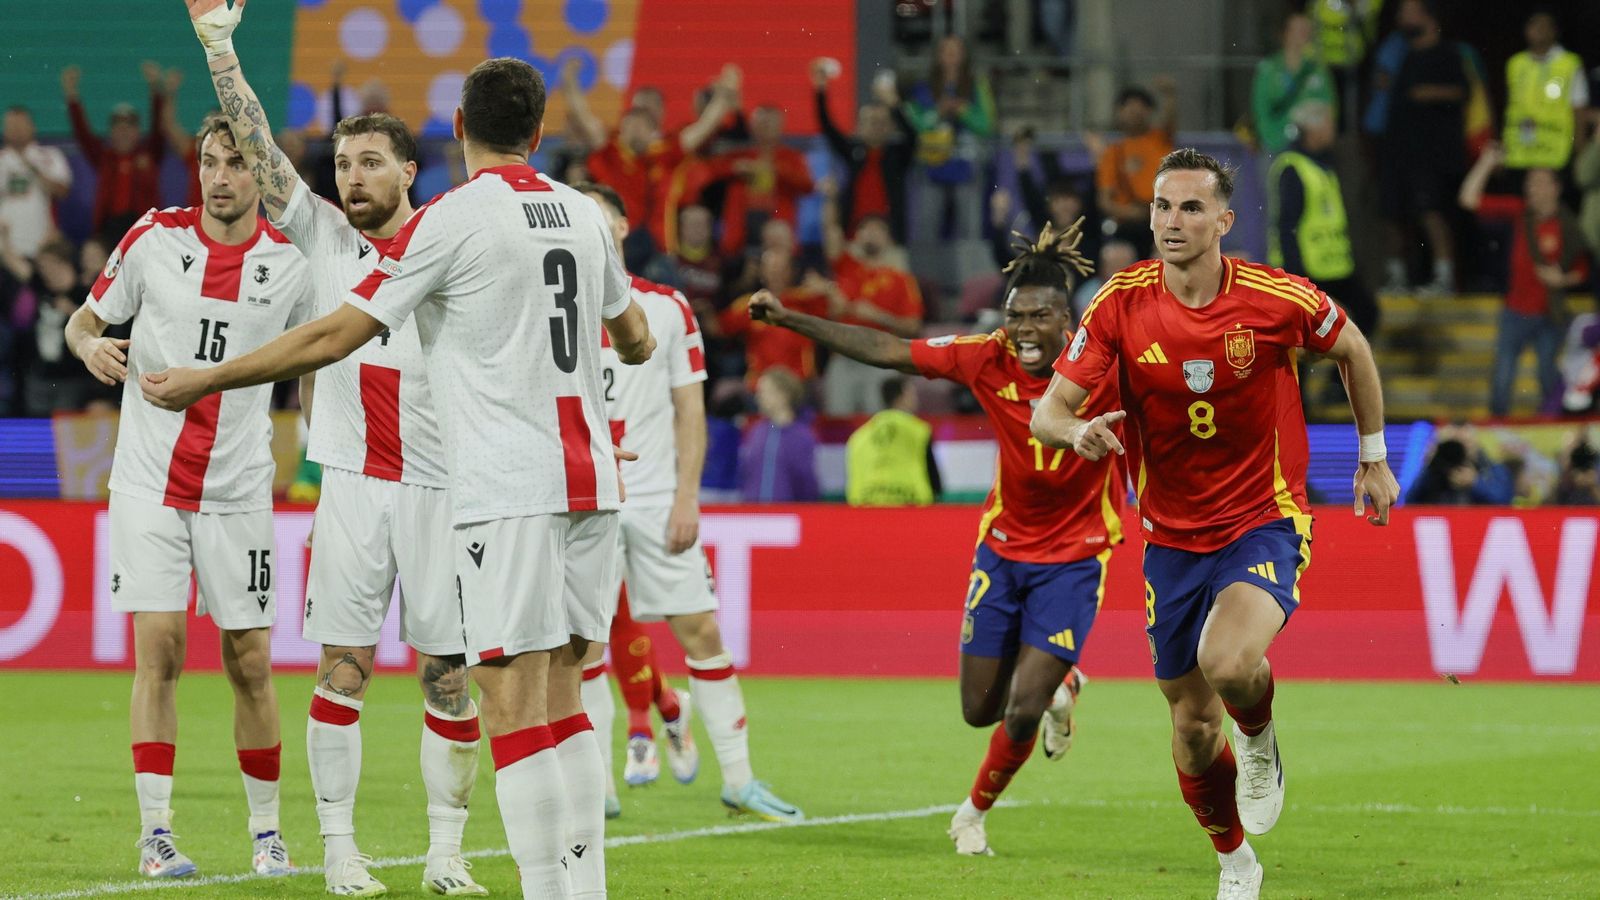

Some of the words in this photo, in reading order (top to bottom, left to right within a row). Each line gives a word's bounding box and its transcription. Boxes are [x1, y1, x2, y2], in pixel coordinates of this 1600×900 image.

[522, 203, 571, 229] DVALI
[543, 248, 578, 374] 3
[194, 318, 229, 363] 15
[1188, 400, 1217, 439] 8
[247, 550, 270, 592] 15
[1145, 580, 1156, 627] 8
[1412, 516, 1599, 675] W
